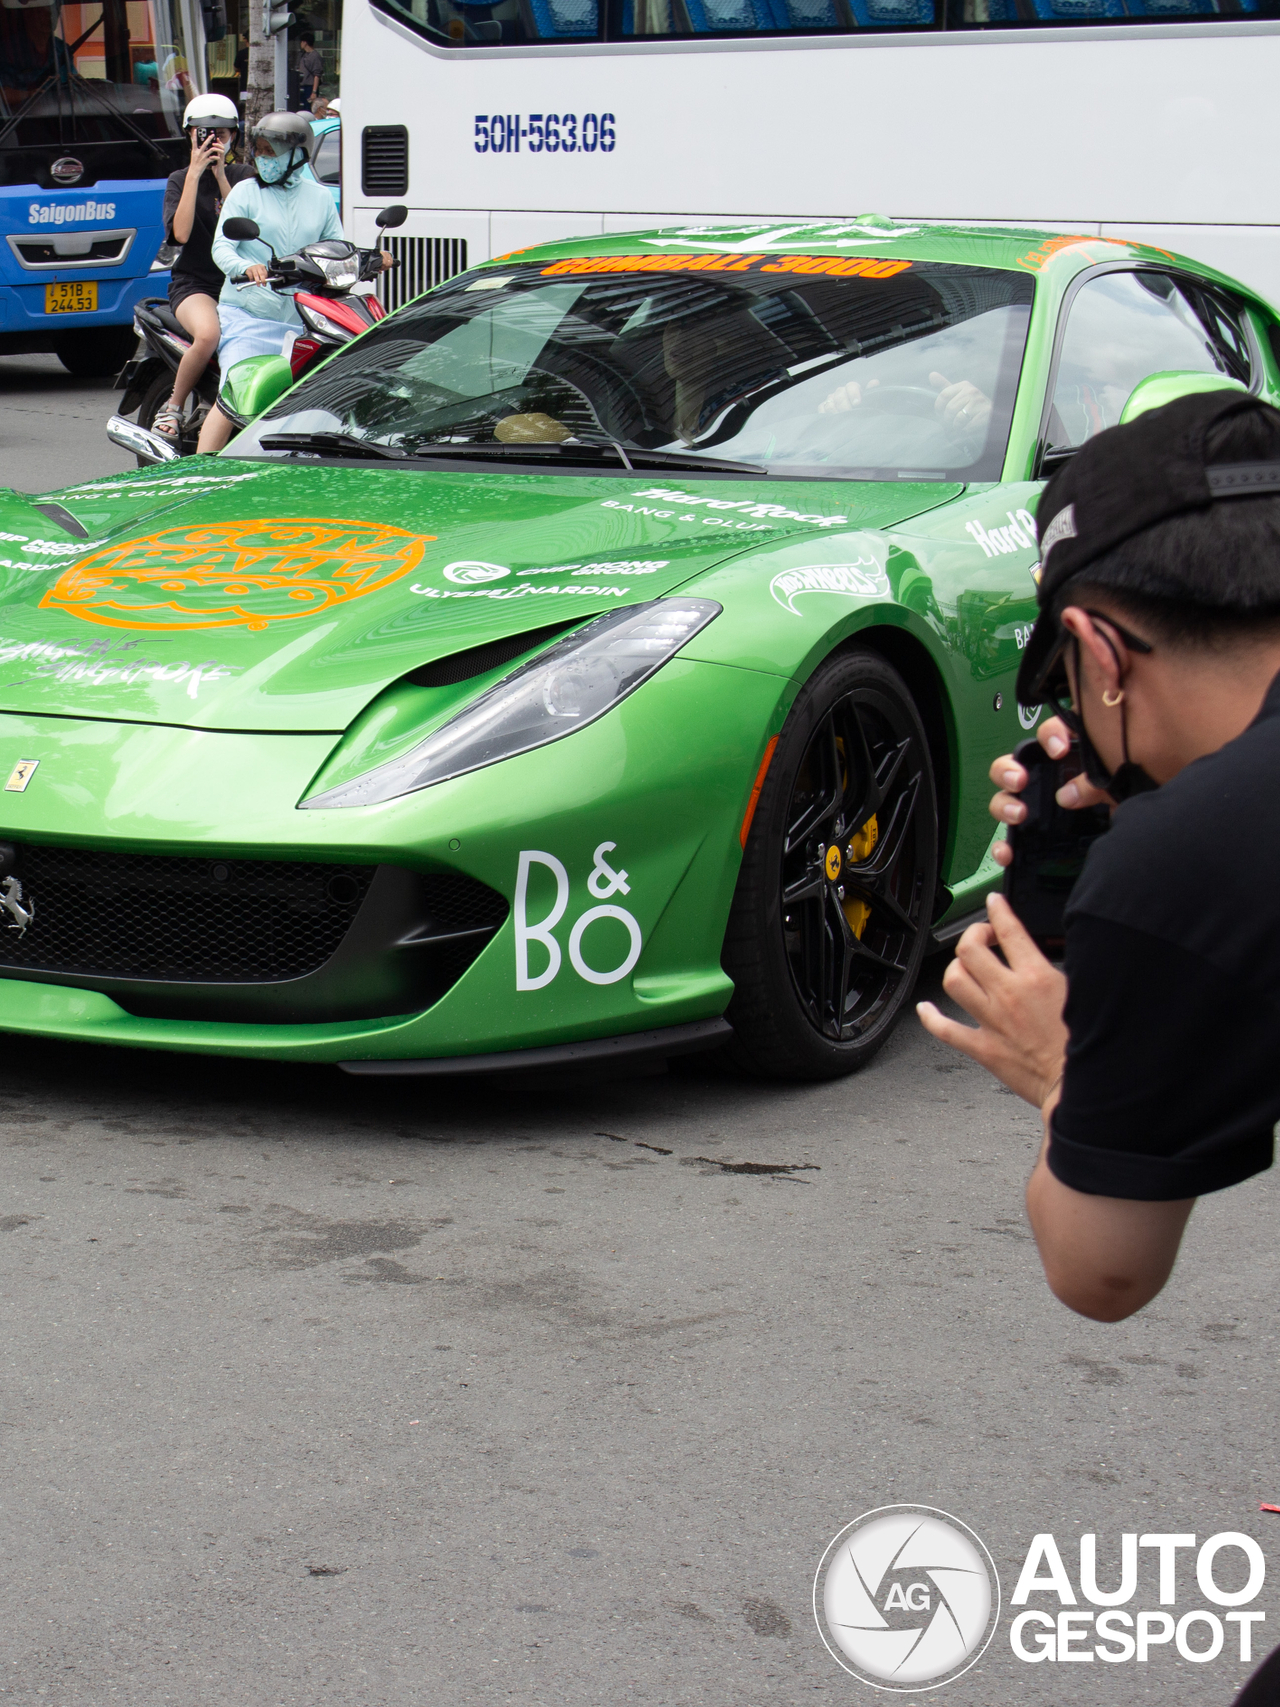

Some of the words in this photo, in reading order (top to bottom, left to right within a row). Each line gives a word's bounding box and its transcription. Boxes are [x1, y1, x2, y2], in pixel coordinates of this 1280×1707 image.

[474, 112, 616, 154] 50H-563.06
[28, 201, 116, 225] SaigonBus
[539, 253, 767, 276] GUMBALL
[760, 256, 913, 279] 3000
[60, 283, 83, 297] 51B
[50, 297, 92, 312] 244.53
[127, 483, 235, 497] OLUFSEN
[599, 500, 675, 518] BANG
[678, 514, 696, 522] &
[630, 488, 756, 510] Hard
[737, 503, 849, 527] Rock
[965, 510, 1034, 559] Hard
[515, 564, 583, 576] CHIP
[580, 560, 670, 570] MONG
[570, 568, 658, 576] GROUP
[408, 583, 510, 599] ULYSSE
[522, 585, 631, 597] NARDIN
[8, 653, 245, 699] SINGAPORE
